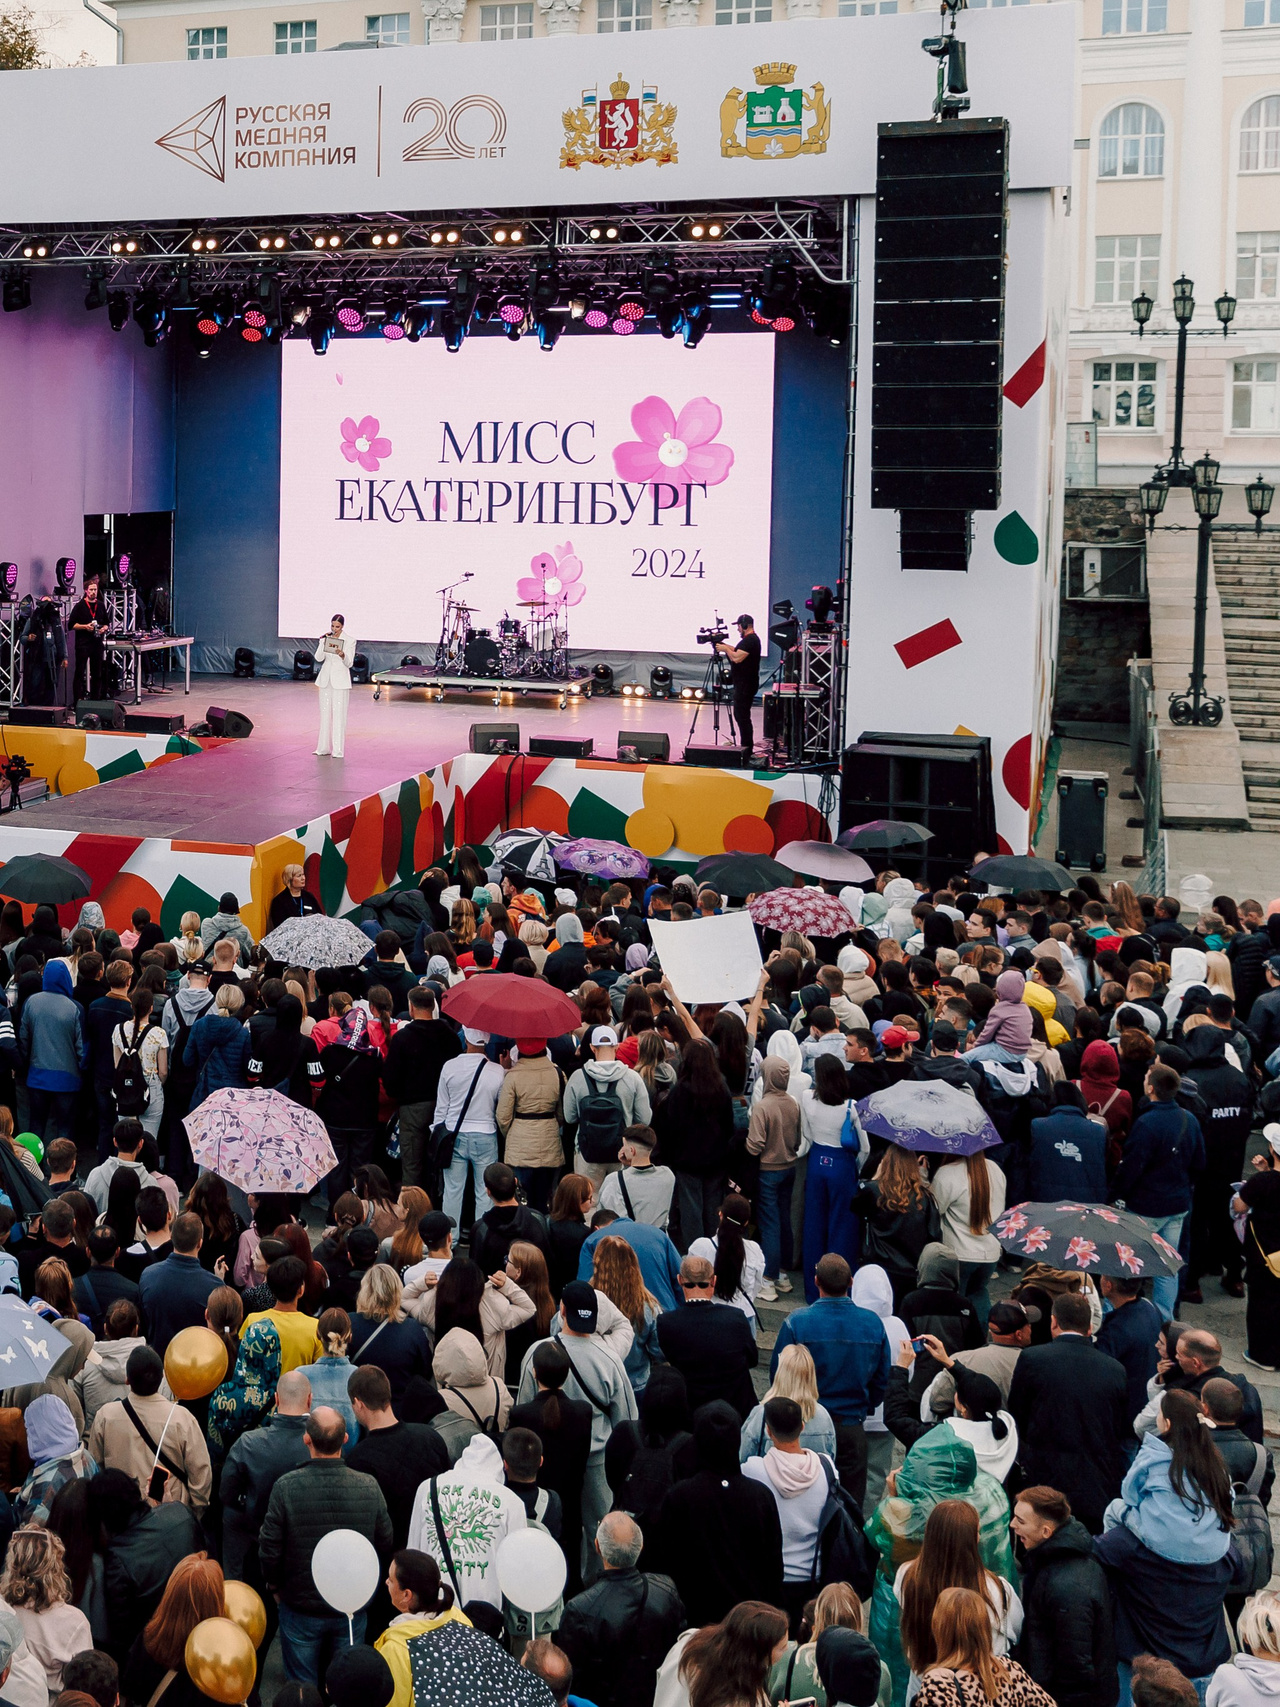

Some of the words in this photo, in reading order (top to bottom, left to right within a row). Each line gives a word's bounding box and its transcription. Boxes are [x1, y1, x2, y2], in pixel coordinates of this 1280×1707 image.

[235, 103, 331, 125] РУССКАЯ
[235, 125, 327, 147] МЕДНАЯ
[402, 94, 507, 162] 20
[235, 147, 356, 169] КОМПАНИЯ
[477, 146, 507, 159] ЛЕТ
[438, 419, 596, 464] МИСС
[335, 477, 708, 527] ЕКАТЕРИНБУРГ
[631, 547, 706, 579] 2024
[1212, 1106, 1240, 1118] PARTY
[468, 1486, 501, 1509] AND
[439, 1558, 488, 1579] ORTY
